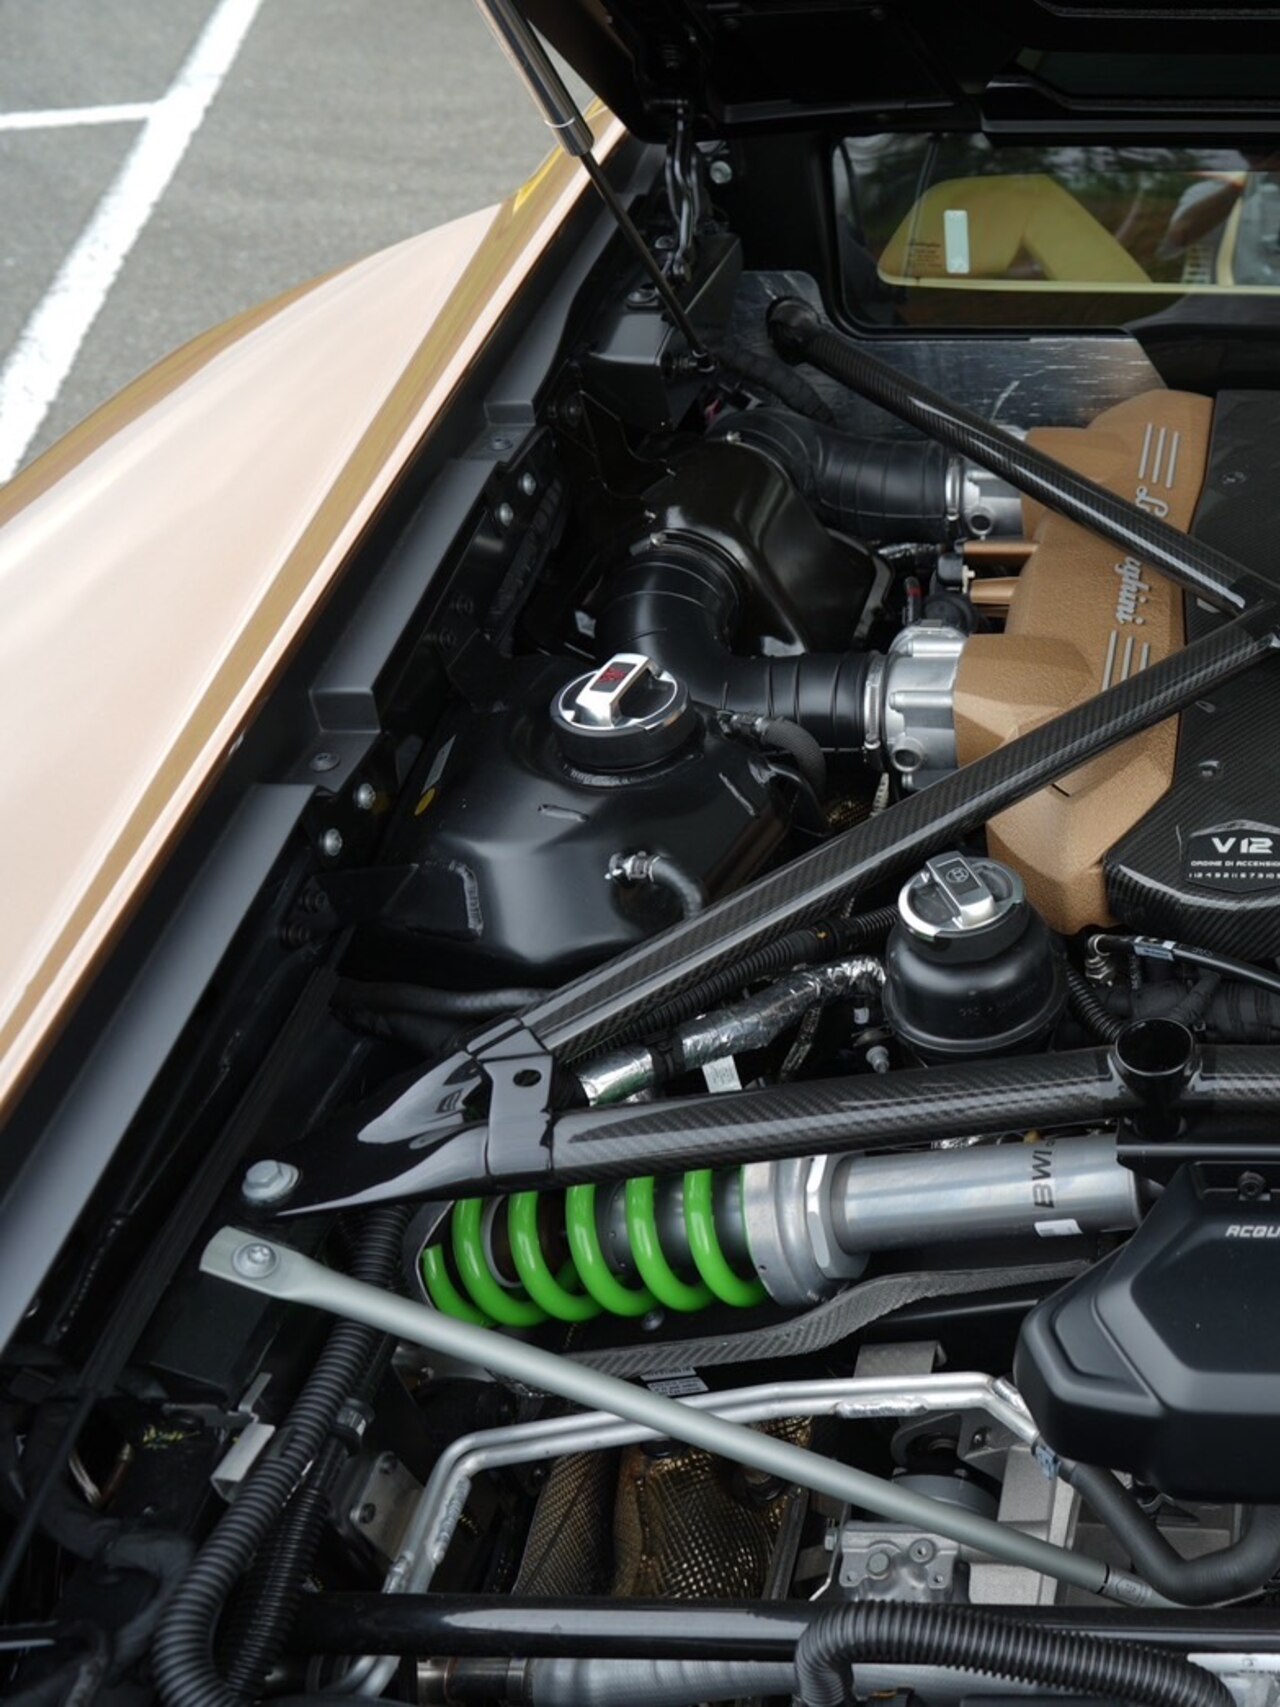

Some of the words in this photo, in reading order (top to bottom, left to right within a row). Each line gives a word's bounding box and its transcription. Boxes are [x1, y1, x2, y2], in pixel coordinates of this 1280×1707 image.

[1115, 486, 1169, 625] Lghini
[1211, 837, 1274, 854] V12
[1032, 1150, 1055, 1209] BWI
